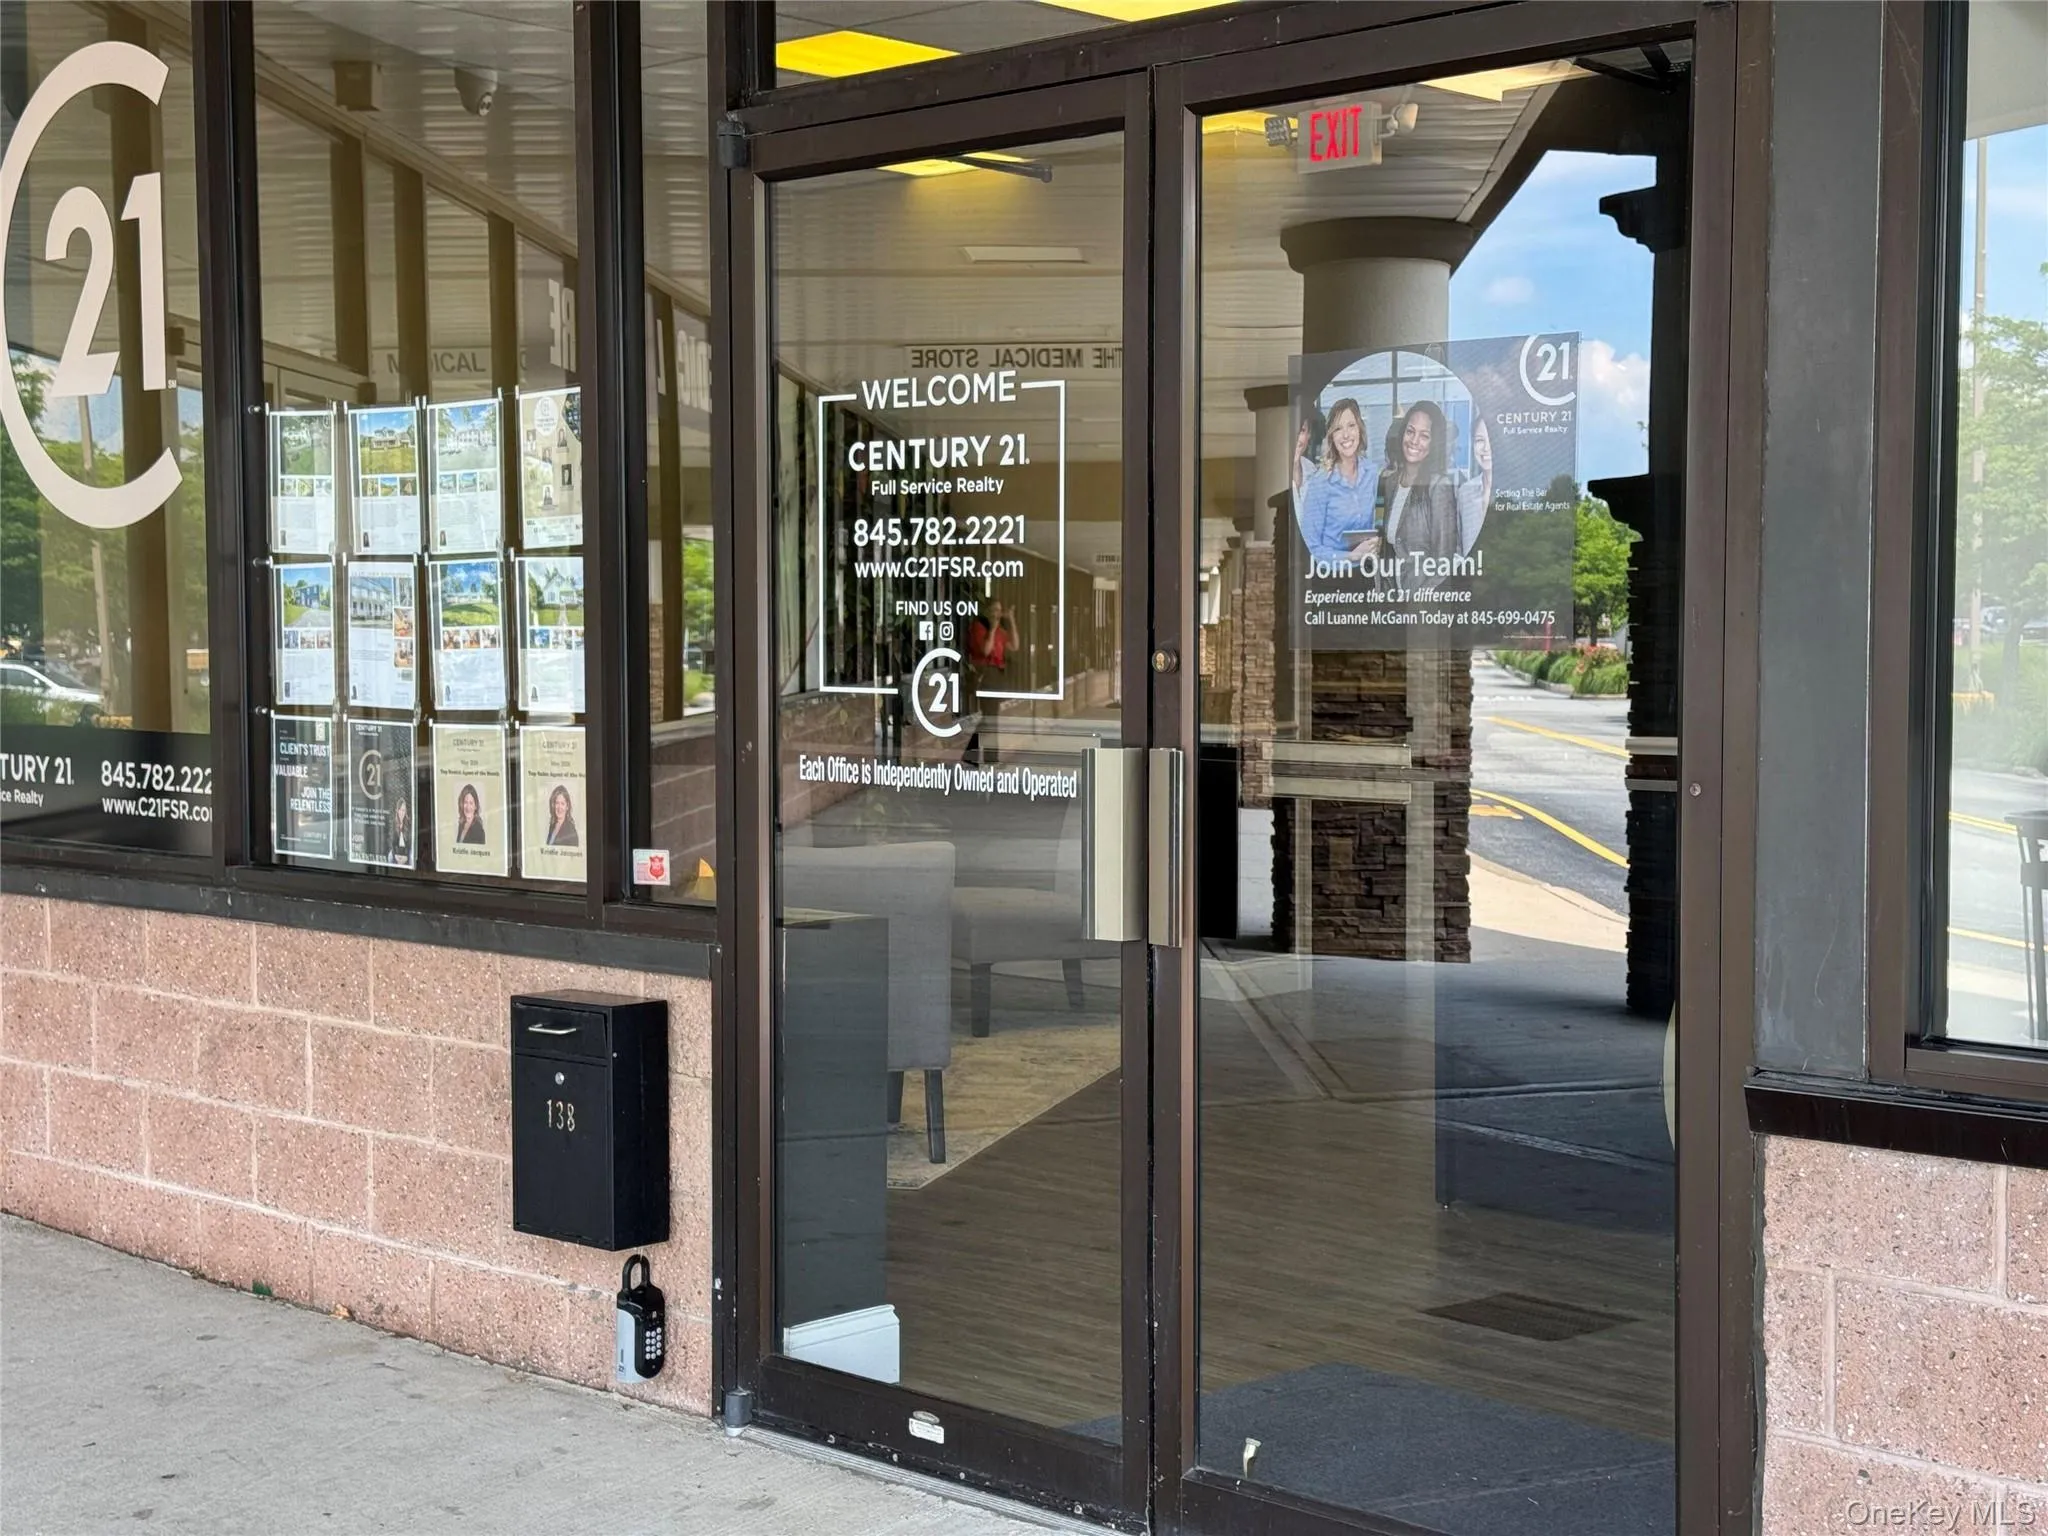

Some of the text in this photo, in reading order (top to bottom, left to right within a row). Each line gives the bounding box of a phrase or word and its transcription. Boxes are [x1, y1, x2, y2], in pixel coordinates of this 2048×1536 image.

[1309, 104, 1363, 162] EXIT
[861, 370, 1017, 411] WELCOME
[1496, 410, 1558, 424] CENTURY
[848, 435, 992, 472] CENTURY
[871, 476, 1005, 496] Full Service Realty
[1521, 487, 1535, 498] The
[1495, 501, 1570, 512] for Real Estate Agents
[853, 514, 1026, 547] 845.782.2221
[854, 556, 1024, 579] www.C21FSR.com
[1305, 550, 1484, 579] Join Our Team!
[1304, 587, 1472, 607] Experience the C 21 difference
[895, 600, 979, 616] FIND US ON
[1304, 610, 1556, 628] Call Luanne McGann Today at 845-699-0475
[274, 762, 309, 778] VALUABLE
[799, 754, 1078, 801] Each Office is Independently Owned and Operated
[14, 788, 44, 808] Realty
[101, 797, 213, 823] www.C21FSR.co
[546, 1099, 577, 1132] 138
